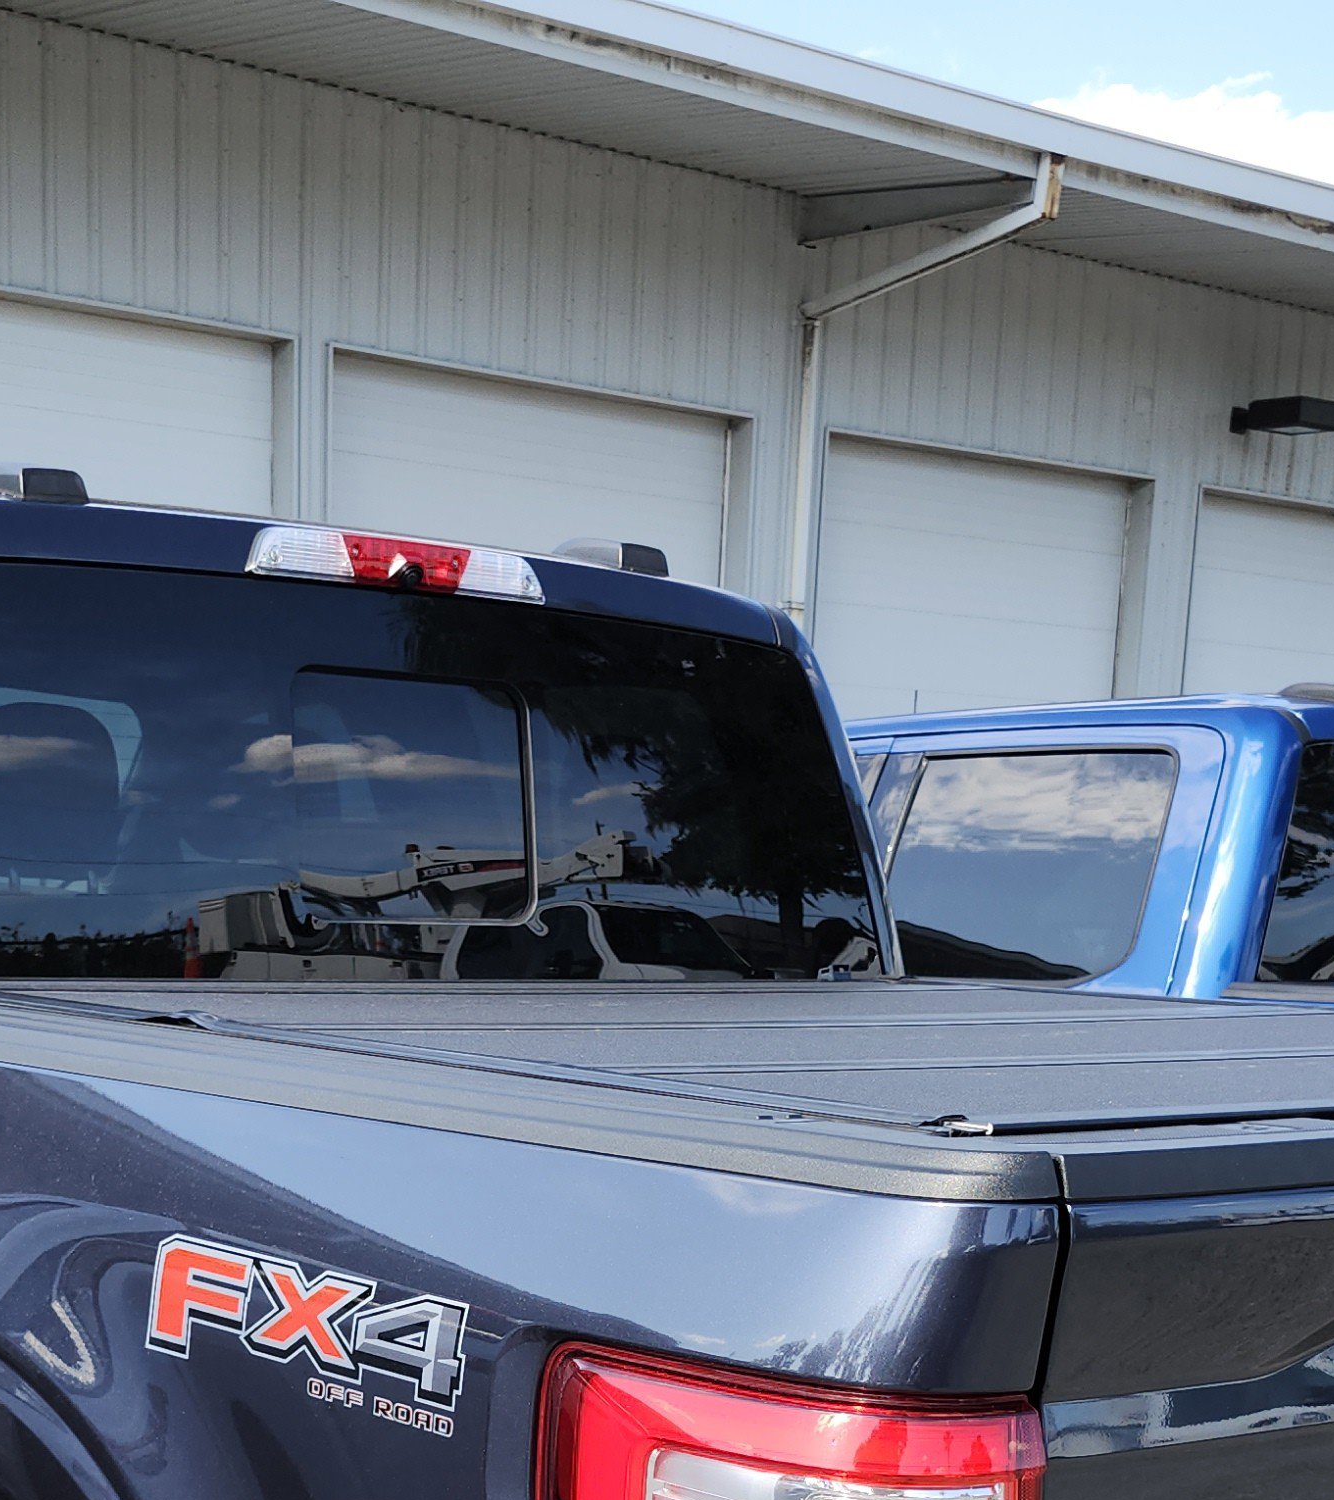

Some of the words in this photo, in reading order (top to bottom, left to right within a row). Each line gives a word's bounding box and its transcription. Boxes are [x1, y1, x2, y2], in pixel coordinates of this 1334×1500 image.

[145, 1233, 469, 1412] FX4
[307, 1377, 363, 1408] OFF
[373, 1396, 454, 1438] ROAD
